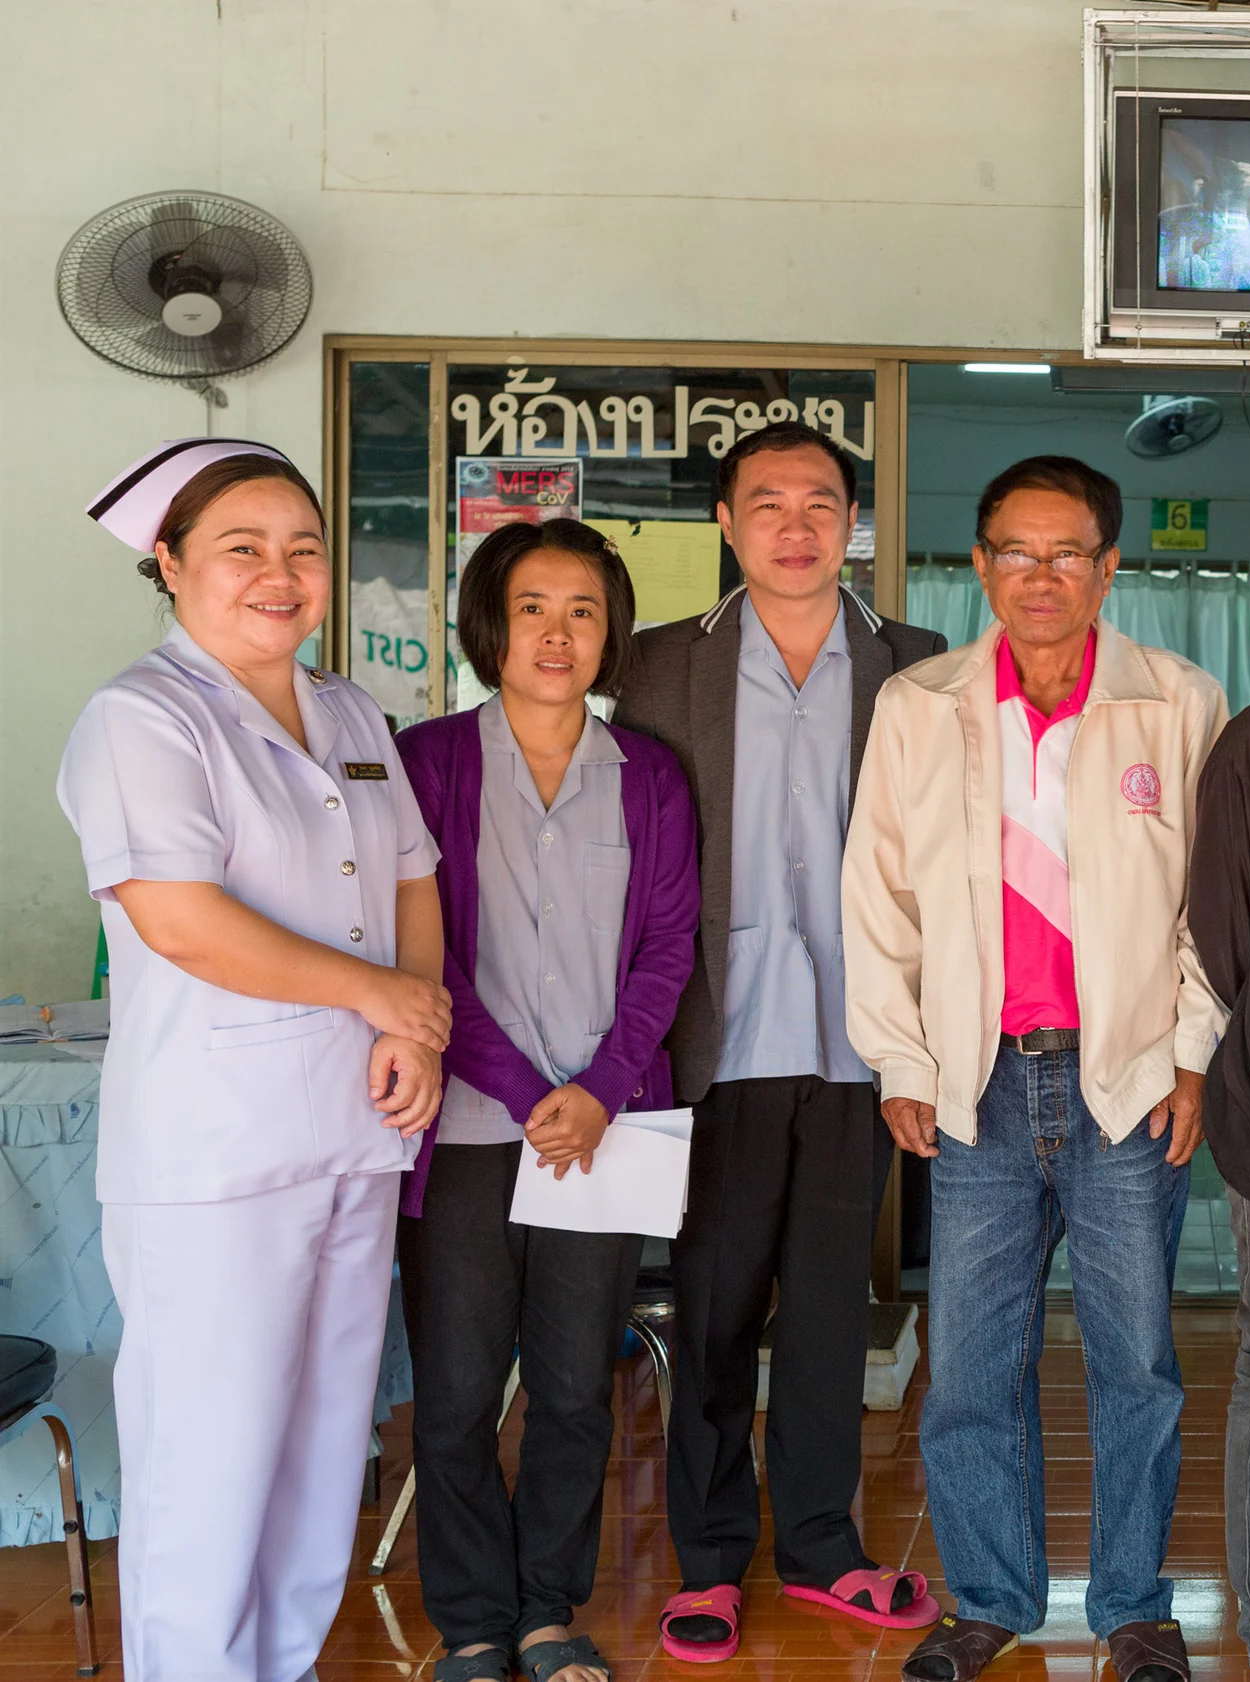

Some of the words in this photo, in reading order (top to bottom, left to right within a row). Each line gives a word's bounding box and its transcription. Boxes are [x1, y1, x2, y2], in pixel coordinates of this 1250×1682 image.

[496, 471, 576, 495] MERS
[536, 491, 569, 505] CoV
[1171, 504, 1188, 530] 6
